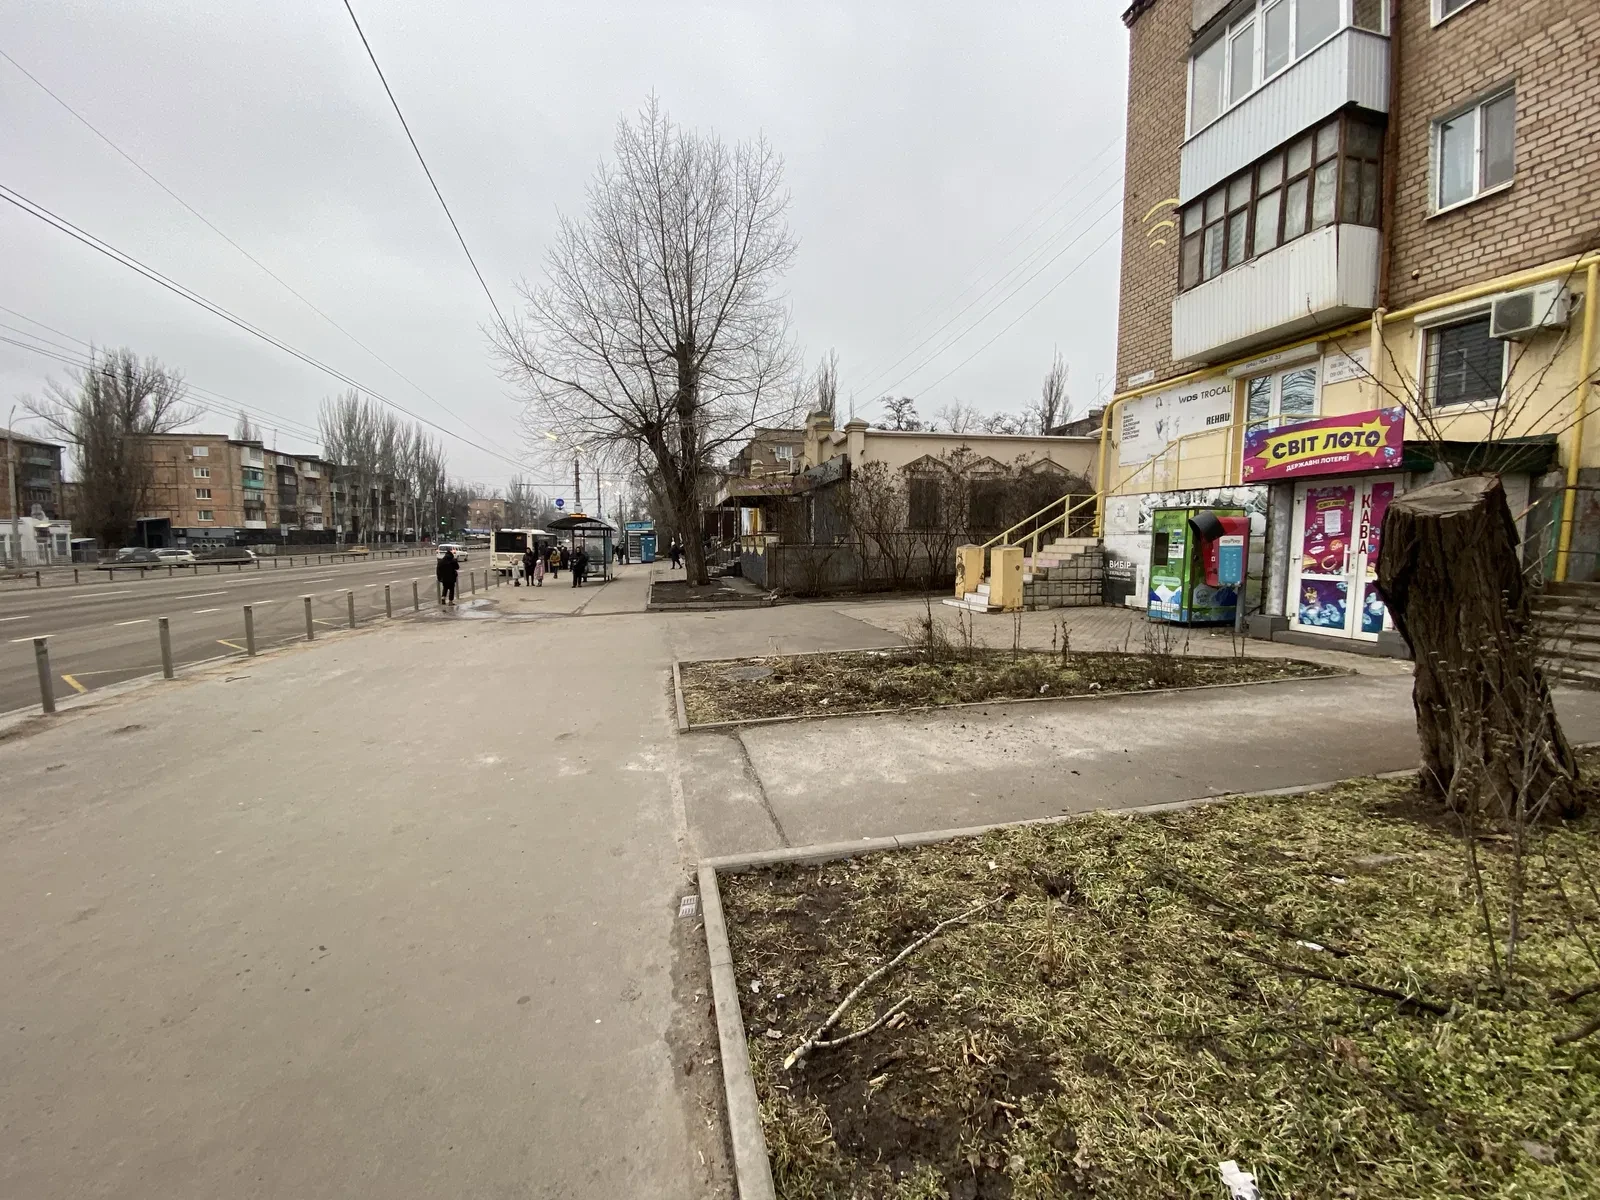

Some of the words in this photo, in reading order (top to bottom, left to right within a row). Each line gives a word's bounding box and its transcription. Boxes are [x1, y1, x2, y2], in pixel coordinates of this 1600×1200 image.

[1178, 394, 1198, 404] WDS
[1201, 385, 1231, 400] TROCAL
[1206, 413, 1231, 425] REHAU
[1322, 430, 1380, 449] ЛОТО
[1286, 459, 1320, 472] ДЕРЖАВНІ
[1320, 454, 1350, 464] ЛОТЕРЕЇ
[1359, 494, 1371, 554] КАВА
[1109, 560, 1131, 569] ВИБІР
